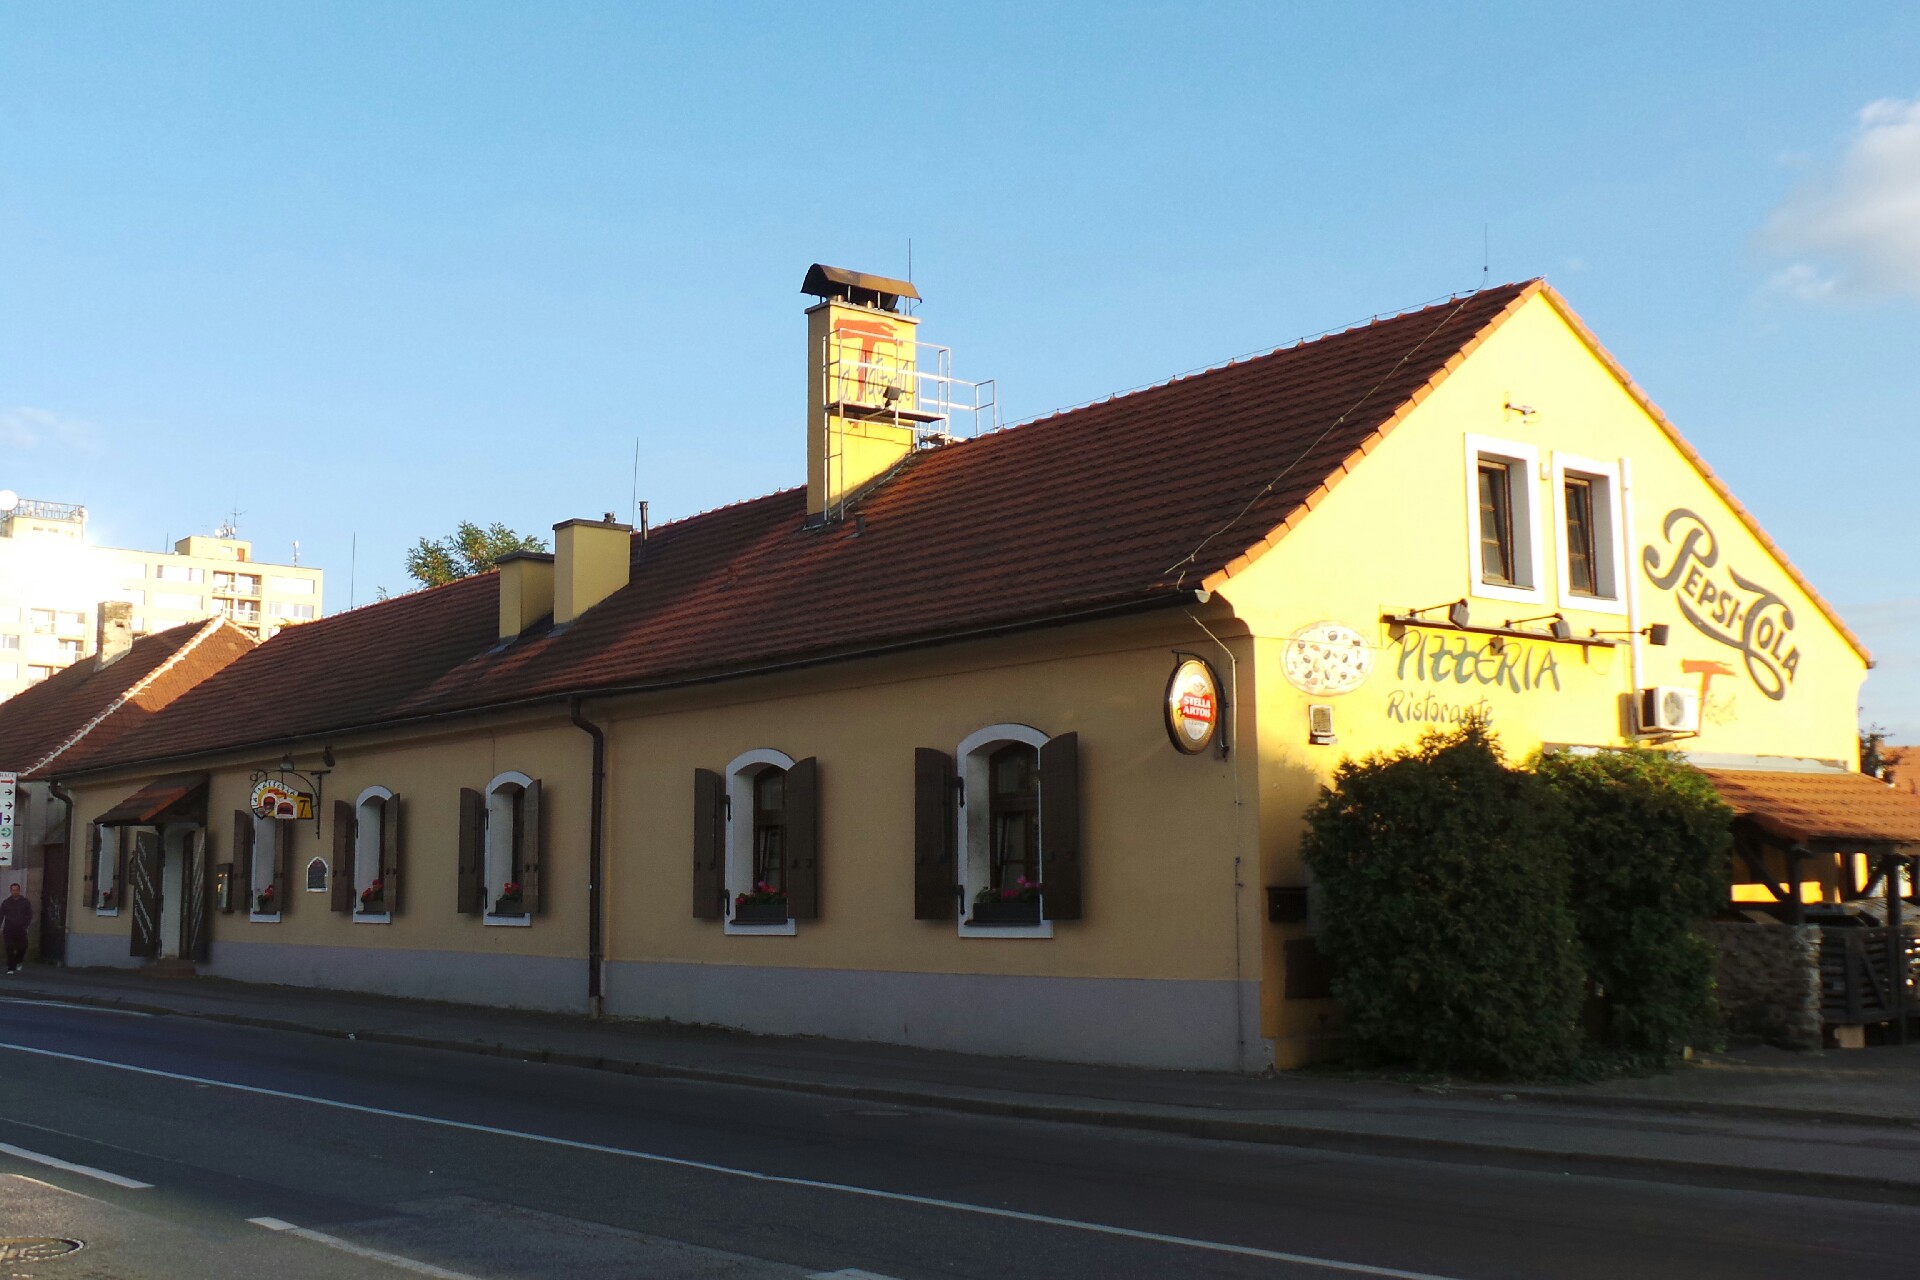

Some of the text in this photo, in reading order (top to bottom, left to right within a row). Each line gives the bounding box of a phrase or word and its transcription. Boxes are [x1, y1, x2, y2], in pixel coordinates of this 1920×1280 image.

[1388, 630, 1561, 694] PIZZERIA
[1183, 696, 1211, 709] STELLA
[1183, 706, 1212, 718] ARTOIS
